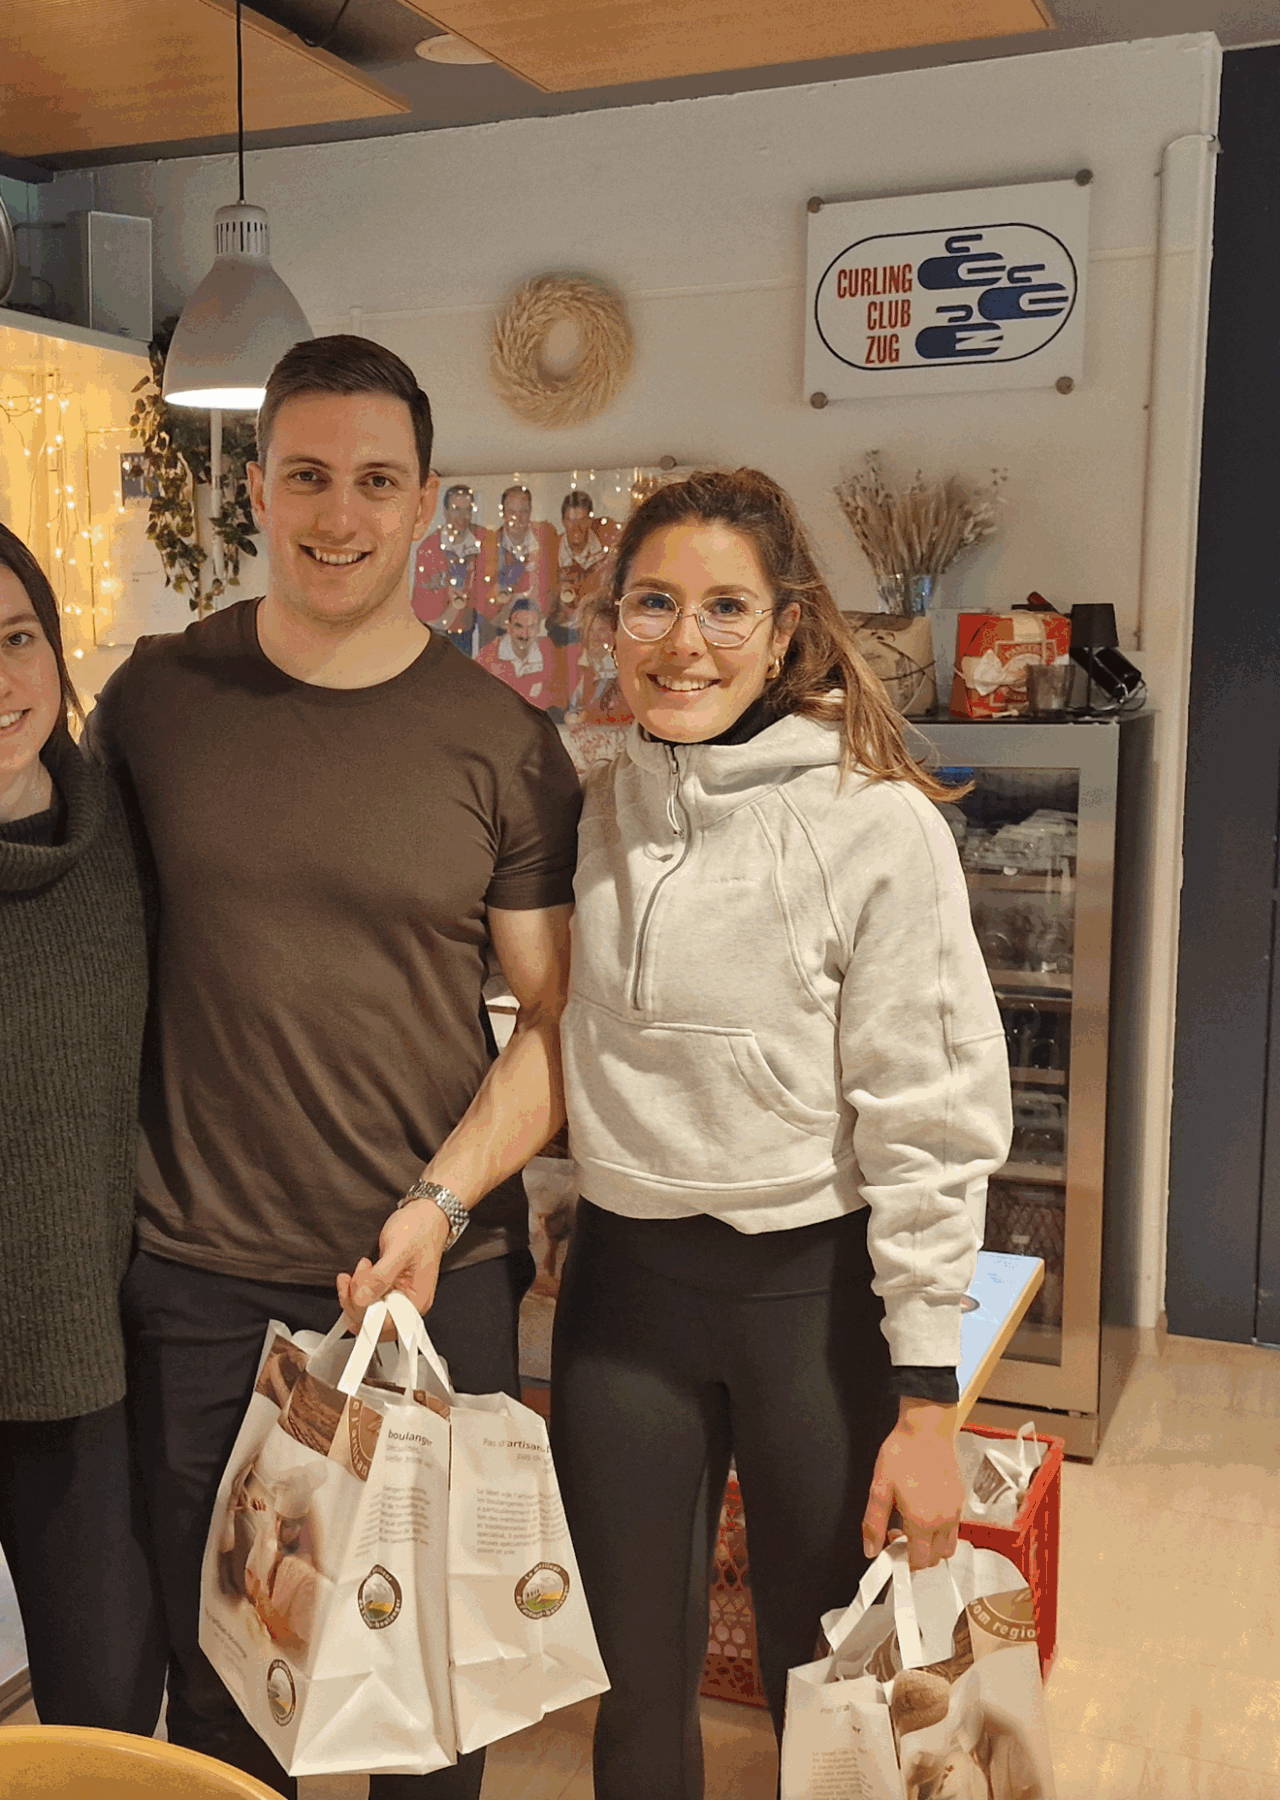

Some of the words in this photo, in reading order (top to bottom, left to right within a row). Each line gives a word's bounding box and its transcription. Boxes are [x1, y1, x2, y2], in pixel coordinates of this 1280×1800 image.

[837, 263, 913, 299] CURLING
[867, 299, 911, 331] CLUB
[865, 333, 900, 365] ZUG
